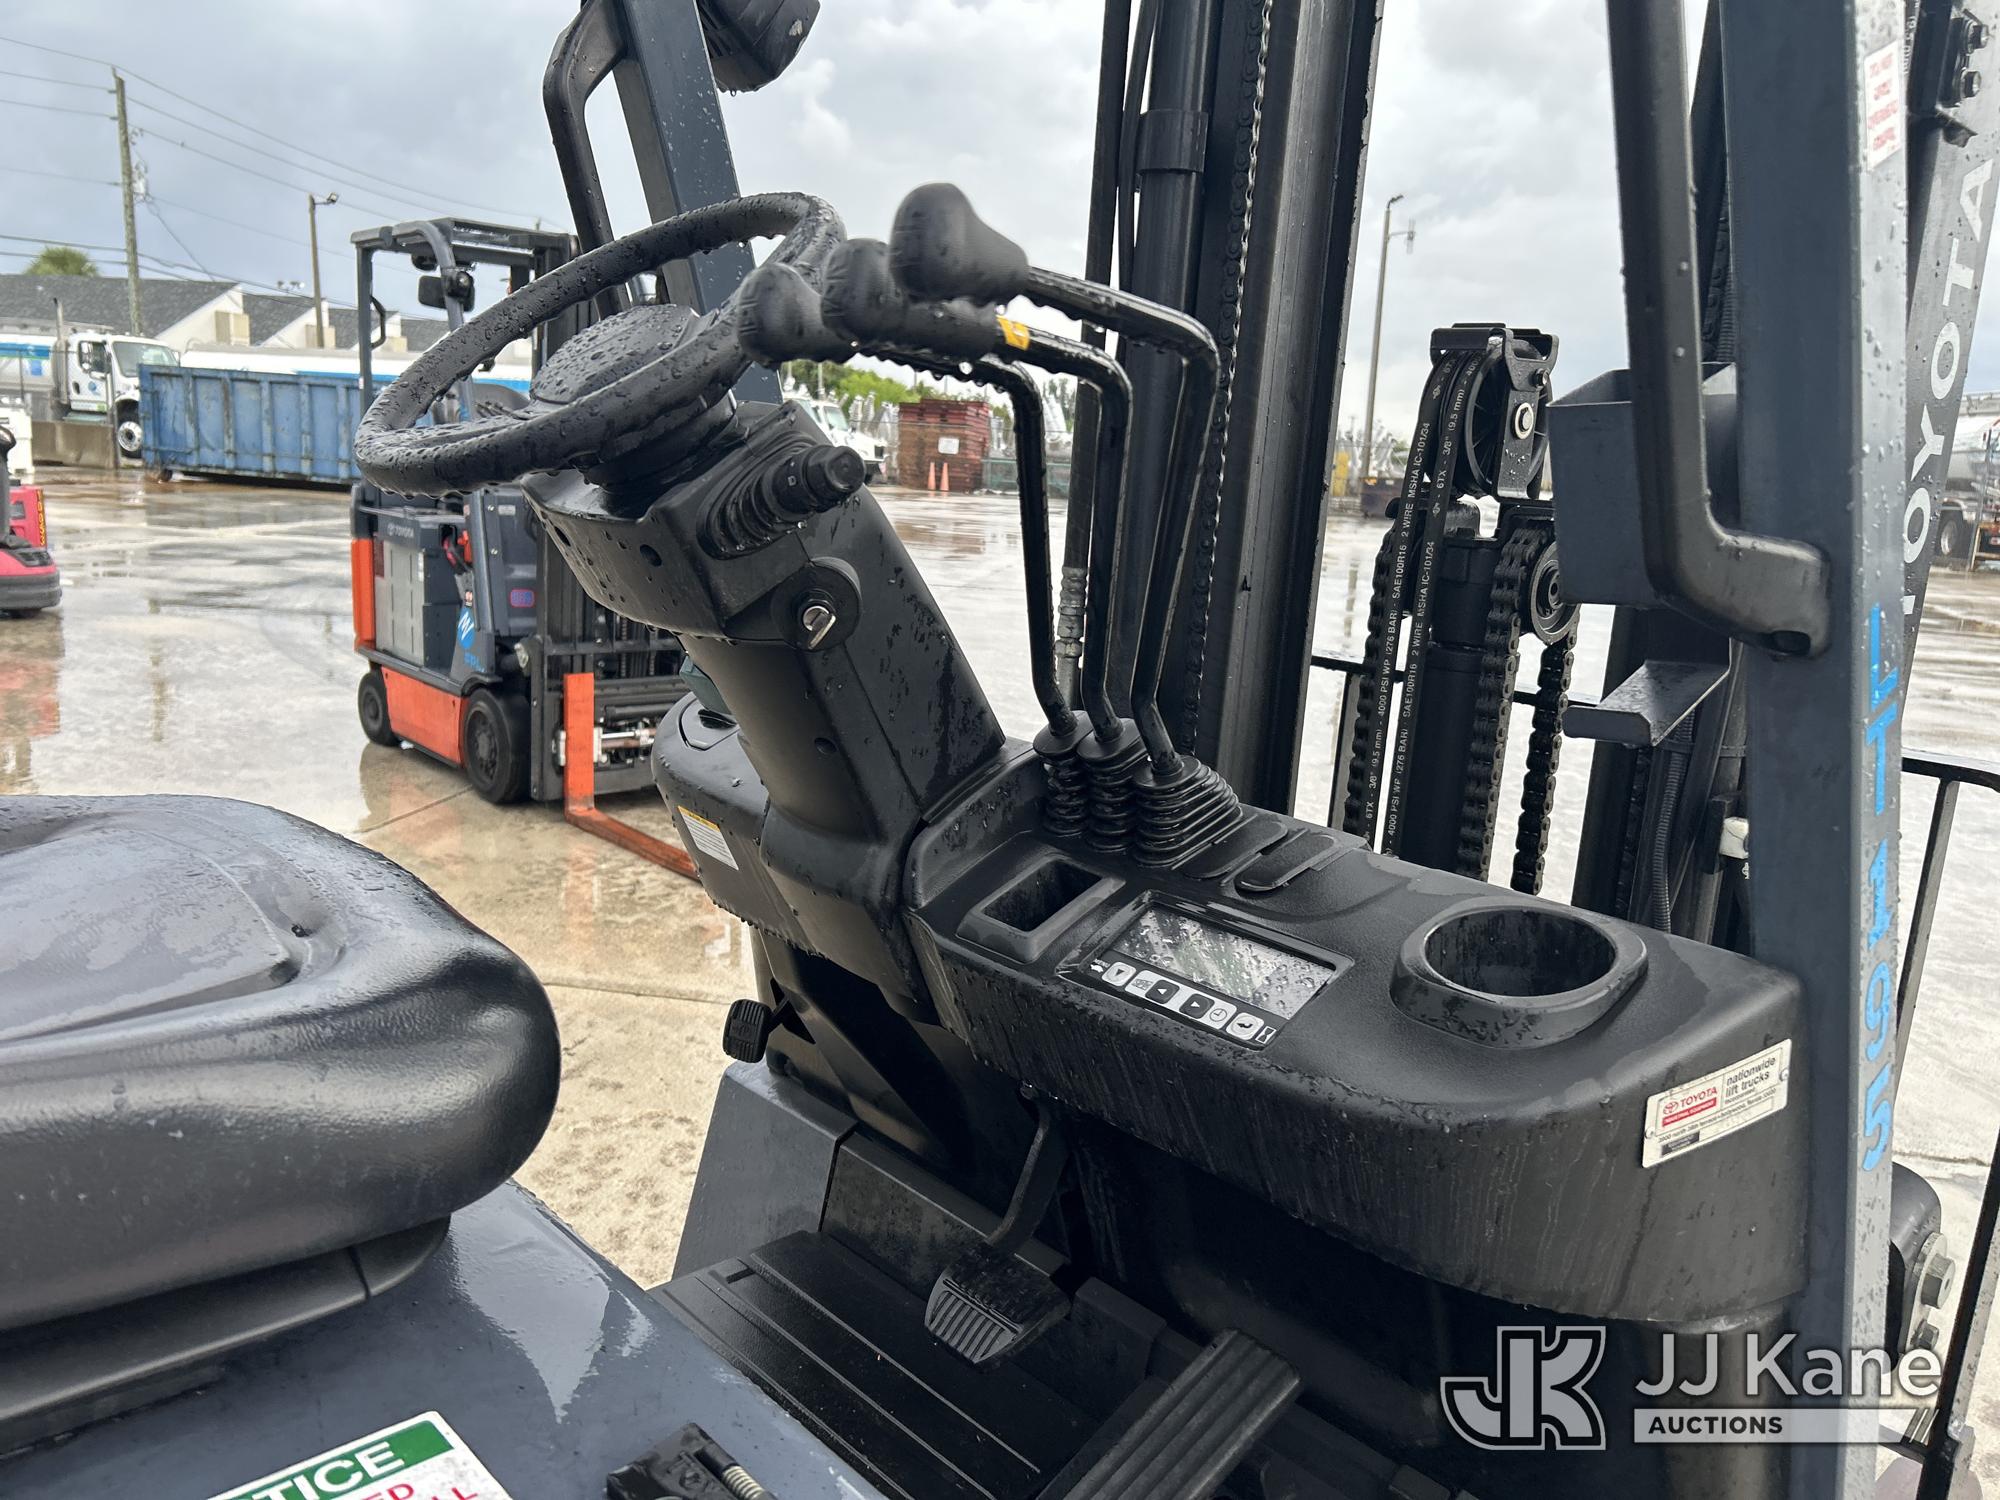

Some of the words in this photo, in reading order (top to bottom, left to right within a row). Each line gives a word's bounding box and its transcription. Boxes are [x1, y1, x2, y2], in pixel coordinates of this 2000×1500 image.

[1903, 159, 1993, 616] OYOTA
[1413, 422, 1430, 466] IC-101/34
[1408, 469, 1420, 498] MSHA
[1402, 503, 1414, 528] WIRE
[1392, 545, 1407, 599] SAE100R16
[1383, 659, 1391, 675] WP
[1388, 814, 1397, 836] 4000
[1403, 664, 1417, 717] SAE100R16
[1413, 623, 1423, 647] WIRE
[1422, 541, 1435, 585] IC-101/34
[1378, 695, 1387, 717] 4000
[1725, 1084, 1738, 1098] lift
[1741, 1071, 1770, 1091] trucks
[1726, 1057, 1776, 1087] nationwide
[1680, 1086, 1718, 1107] TOYOTA
